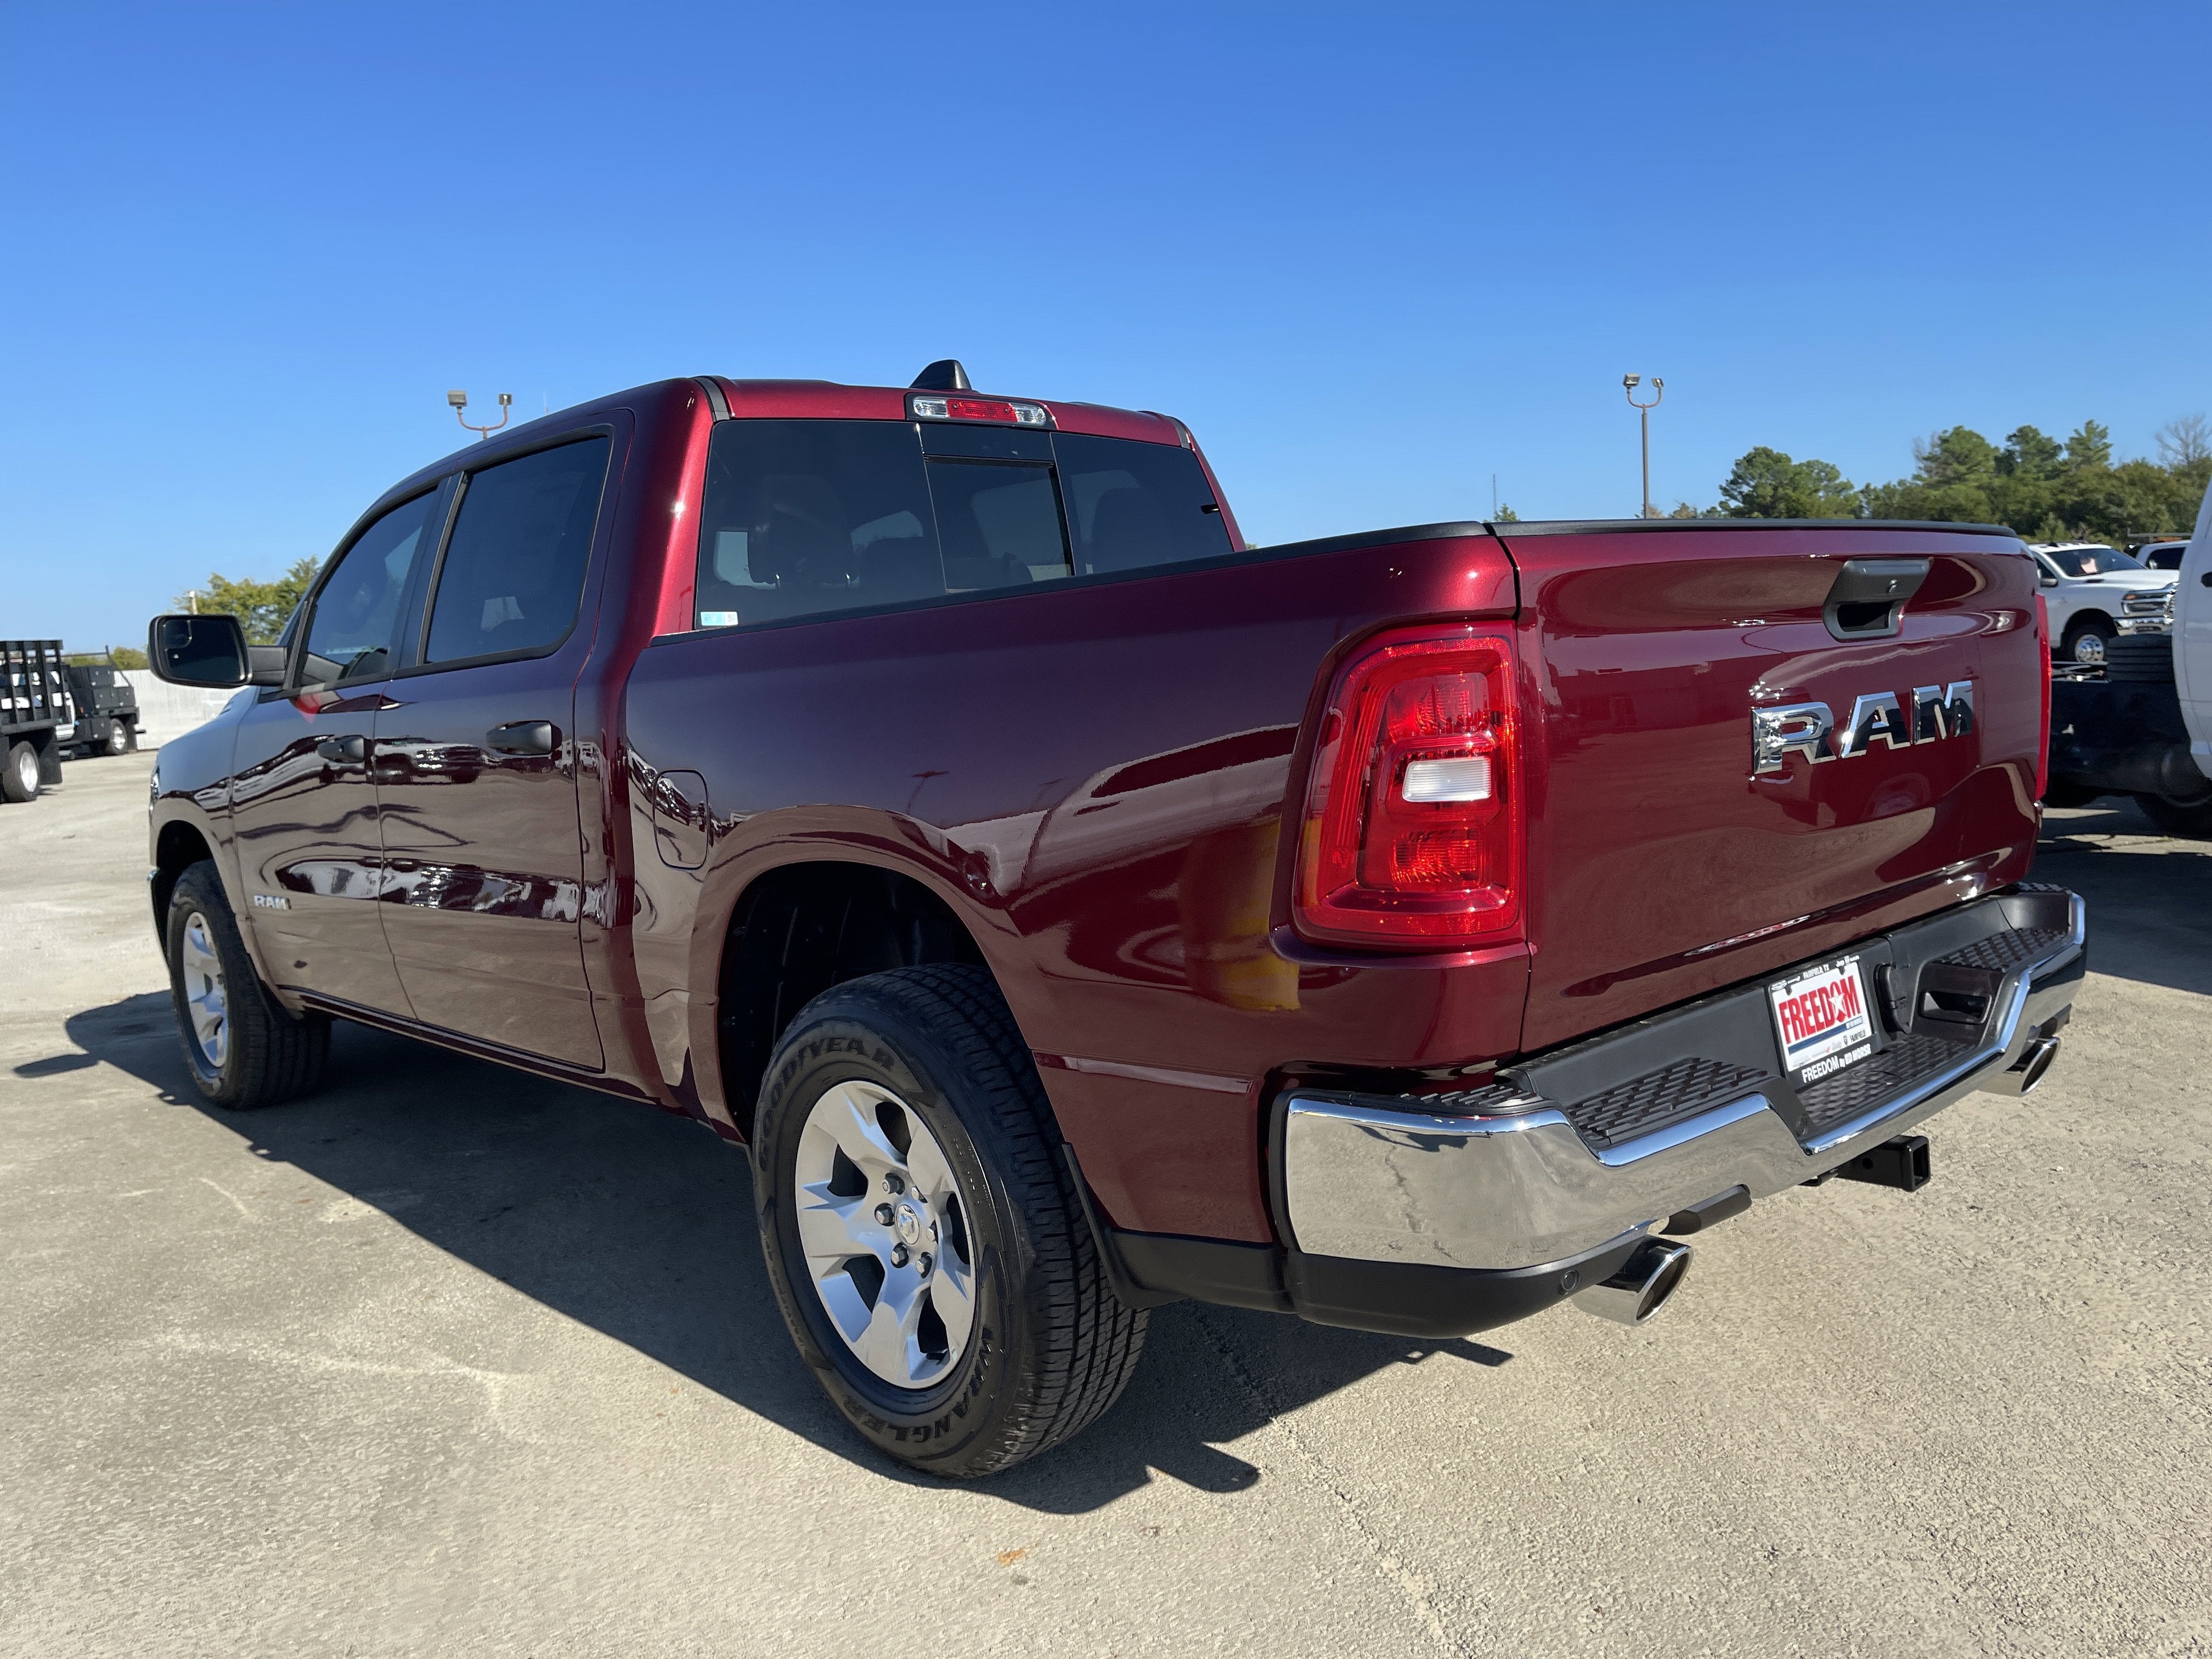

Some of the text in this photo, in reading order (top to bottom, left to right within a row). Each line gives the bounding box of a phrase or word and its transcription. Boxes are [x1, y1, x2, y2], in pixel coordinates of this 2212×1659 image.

[1751, 680, 1973, 775] RAM
[254, 895, 291, 910] RAM
[1779, 975, 1861, 1044] FREEDOM
[758, 1035, 895, 1171] GOODYEAR
[1802, 1056, 1839, 1083] FREEDOM
[843, 1325, 994, 1443] WRANGLER
